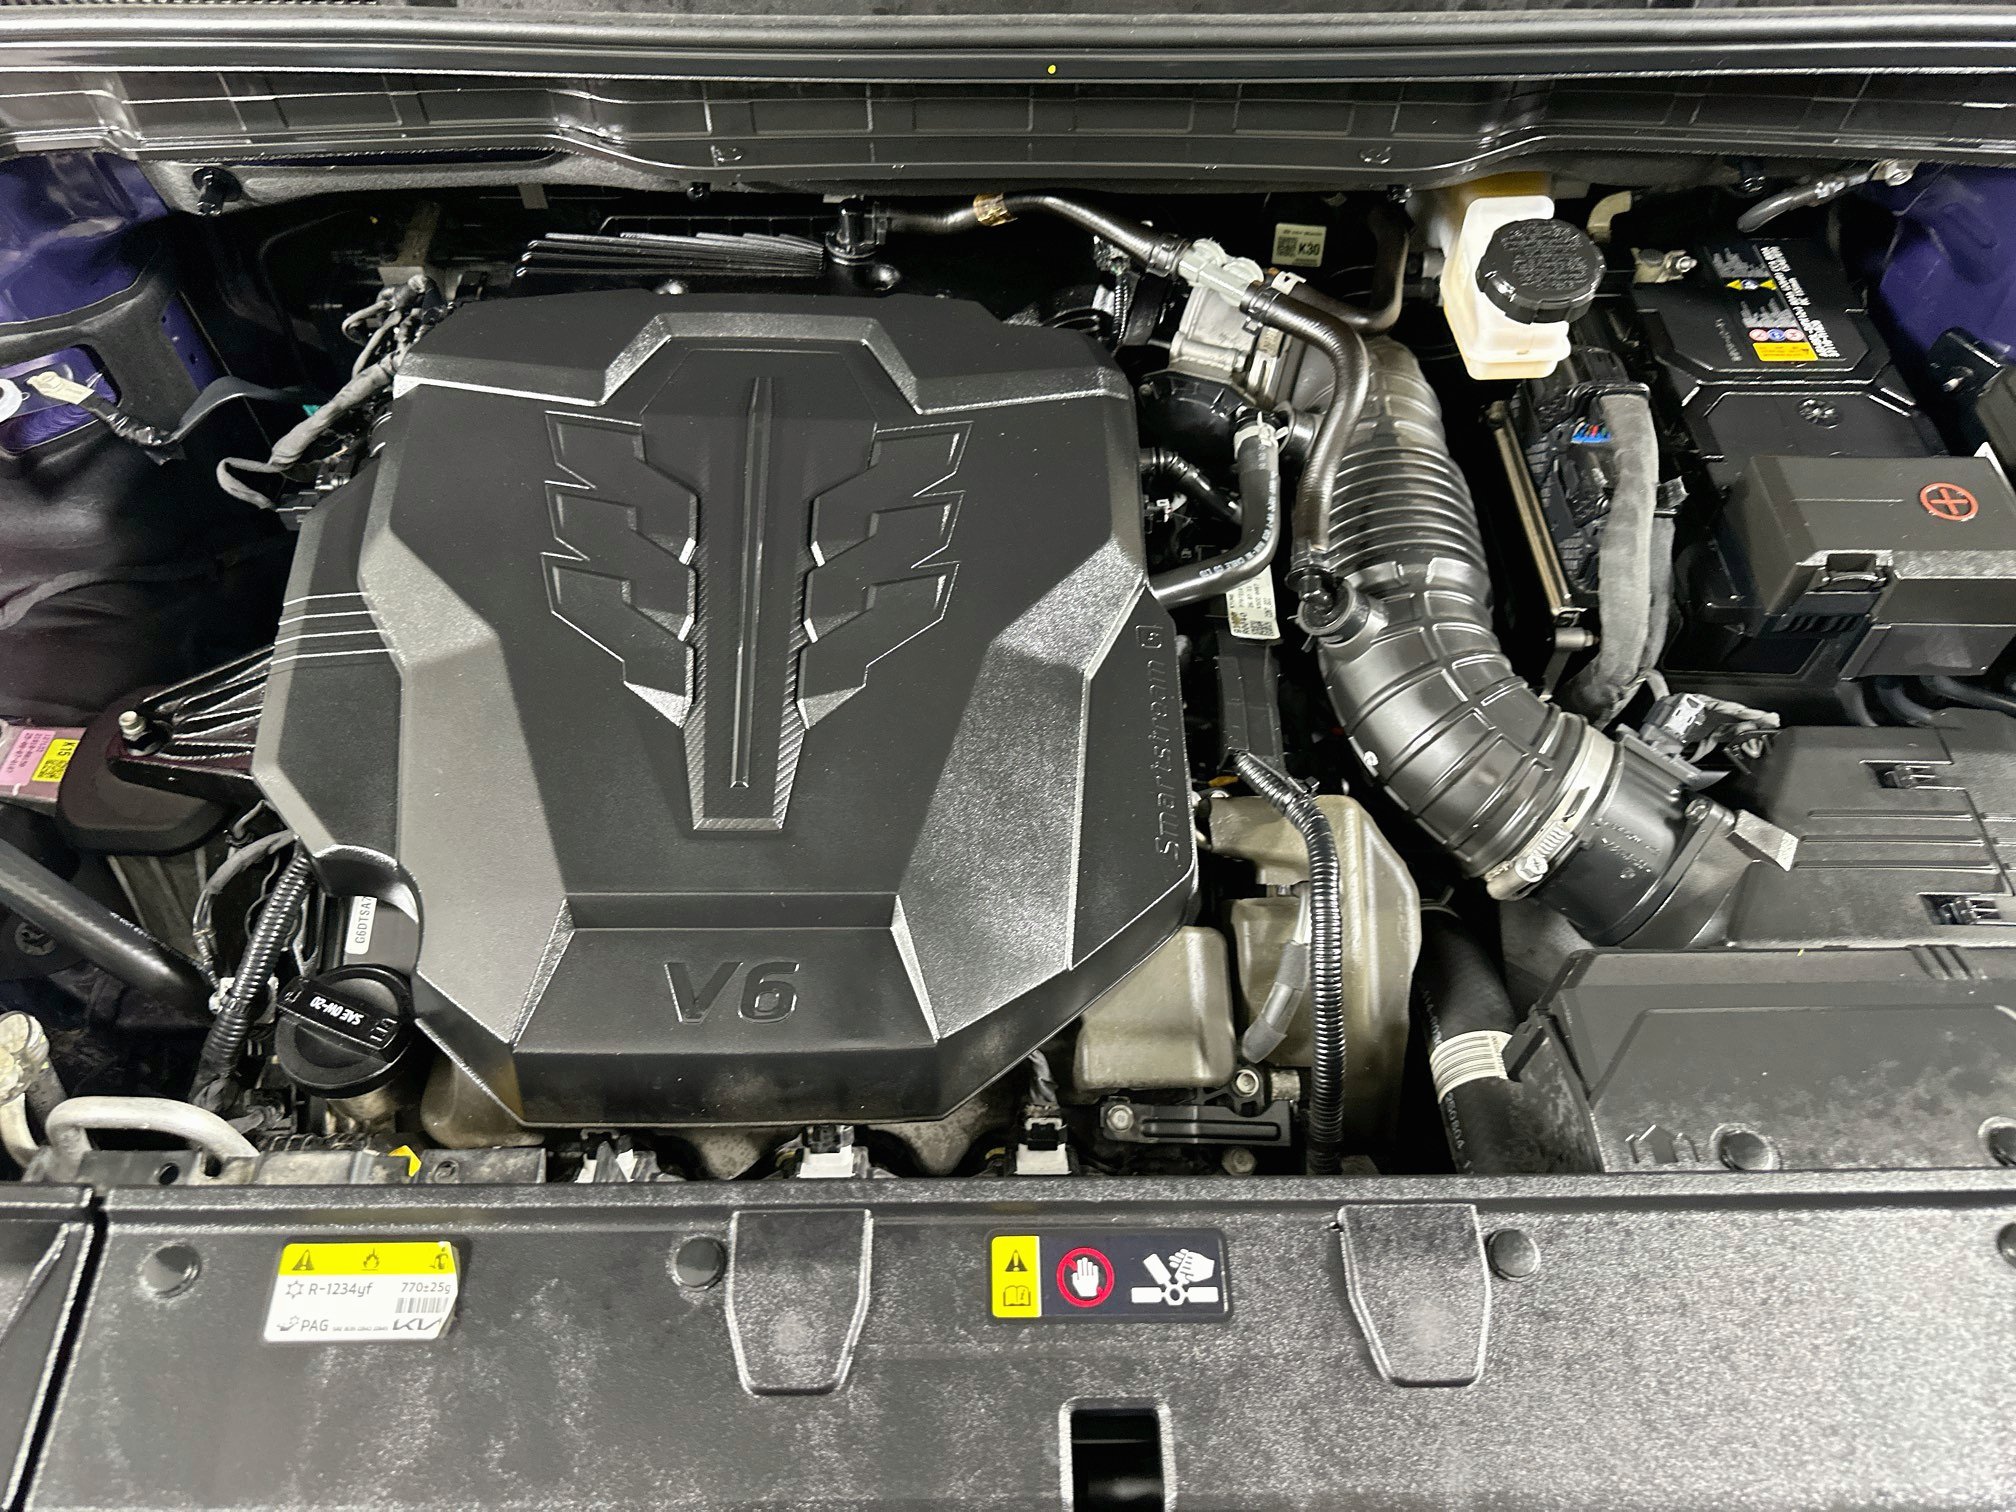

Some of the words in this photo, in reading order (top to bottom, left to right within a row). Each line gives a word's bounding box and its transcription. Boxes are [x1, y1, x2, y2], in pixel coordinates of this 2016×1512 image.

[664, 961, 800, 1024] V6
[309, 996, 344, 1017] 0W-20
[338, 1008, 365, 1025] SAE
[308, 1282, 374, 1297] R-1234yf
[401, 1282, 452, 1294] 770±25g
[300, 1319, 330, 1332] PAG
[393, 1318, 443, 1331] KIA
